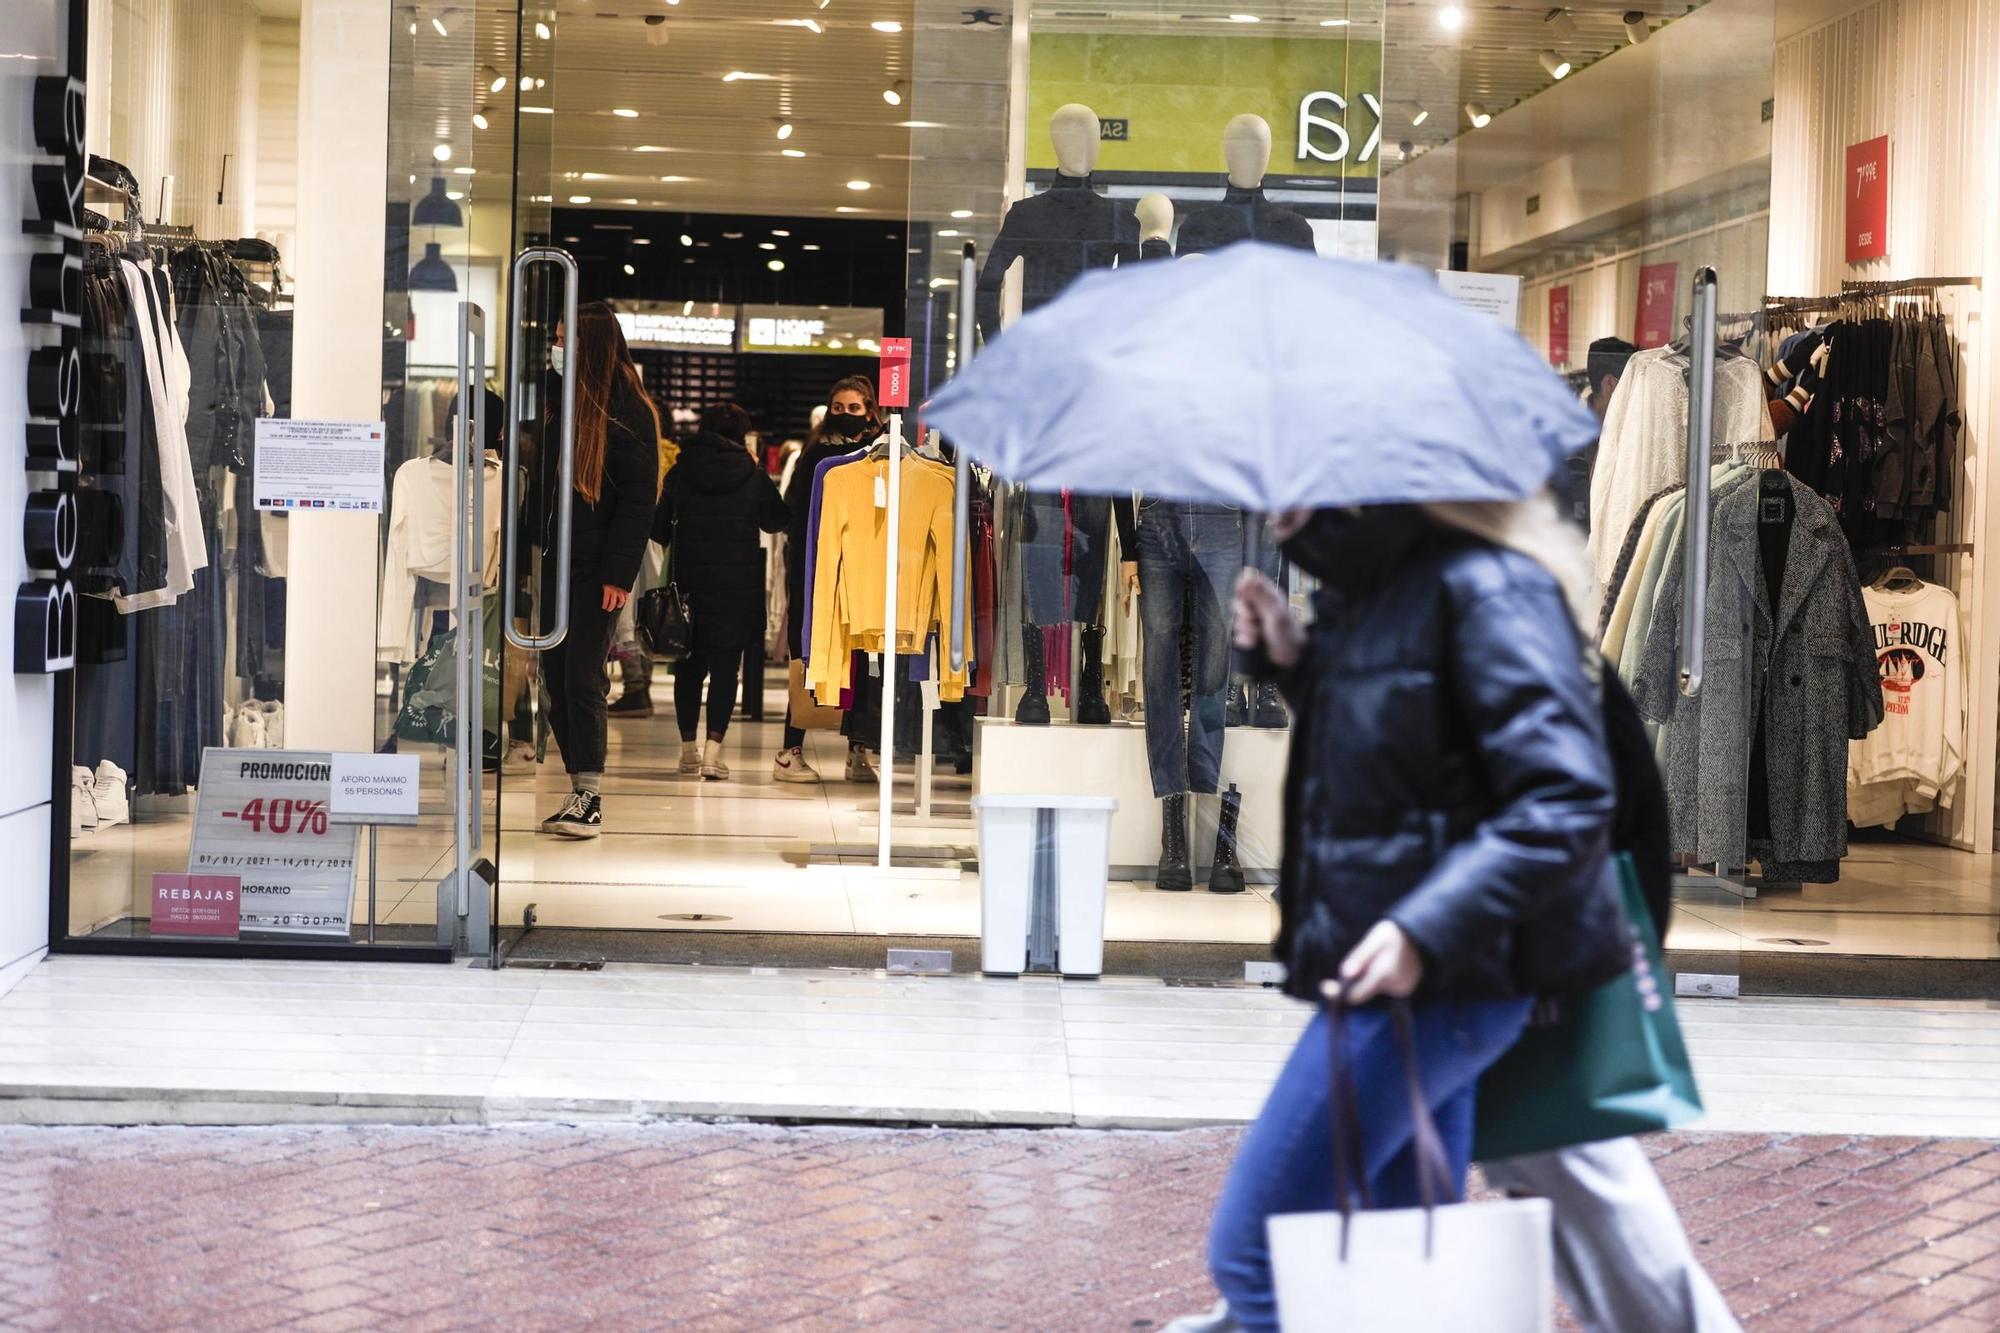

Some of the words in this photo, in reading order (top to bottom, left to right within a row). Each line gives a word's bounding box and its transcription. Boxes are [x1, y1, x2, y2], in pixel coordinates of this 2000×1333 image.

[28, 75, 87, 674] Bershka
[891, 373, 900, 397] TODO
[341, 775, 371, 783] AFORO
[344, 787, 354, 795] 55
[356, 787, 403, 795] PERSONAS
[222, 798, 327, 835] -40%
[159, 888, 234, 901] REBAJAS
[242, 885, 291, 895] HORARIO
